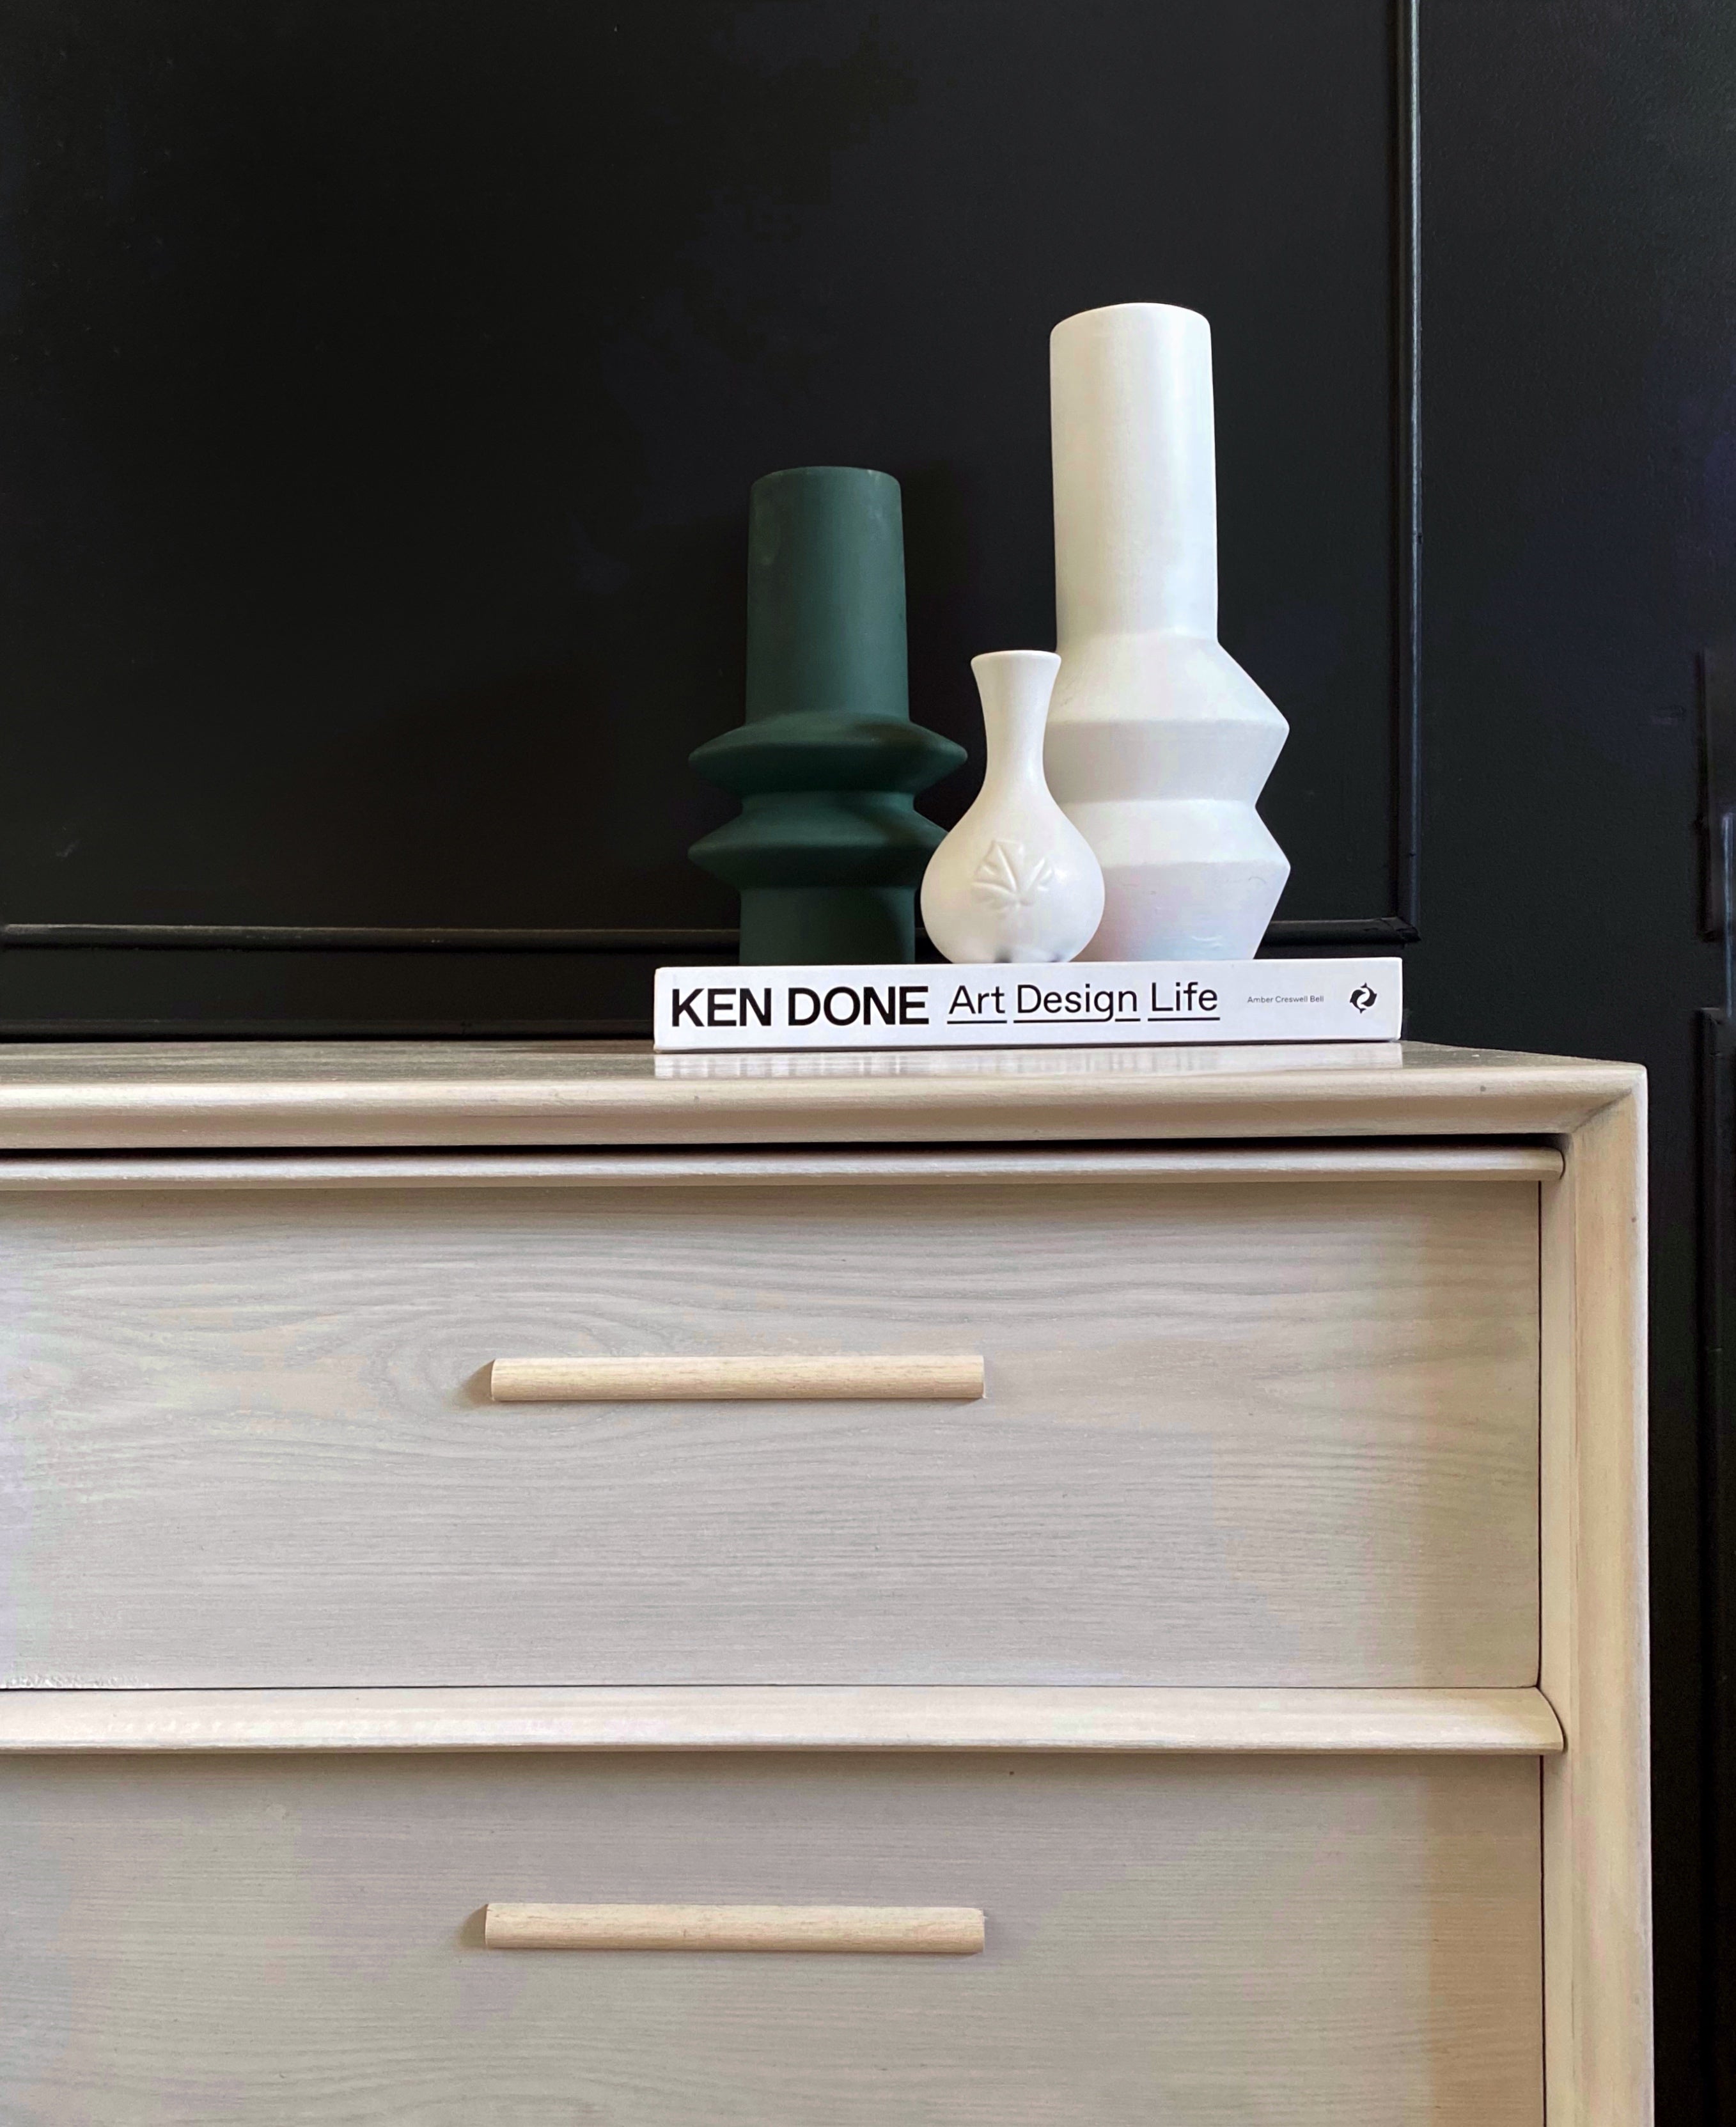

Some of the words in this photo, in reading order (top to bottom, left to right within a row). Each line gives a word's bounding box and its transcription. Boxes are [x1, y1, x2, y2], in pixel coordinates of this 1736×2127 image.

[671, 987, 772, 1027] KEN
[788, 985, 930, 1026] DONE
[948, 985, 1006, 1015] Art
[1017, 983, 1138, 1022] Design
[1152, 981, 1218, 1012] Life
